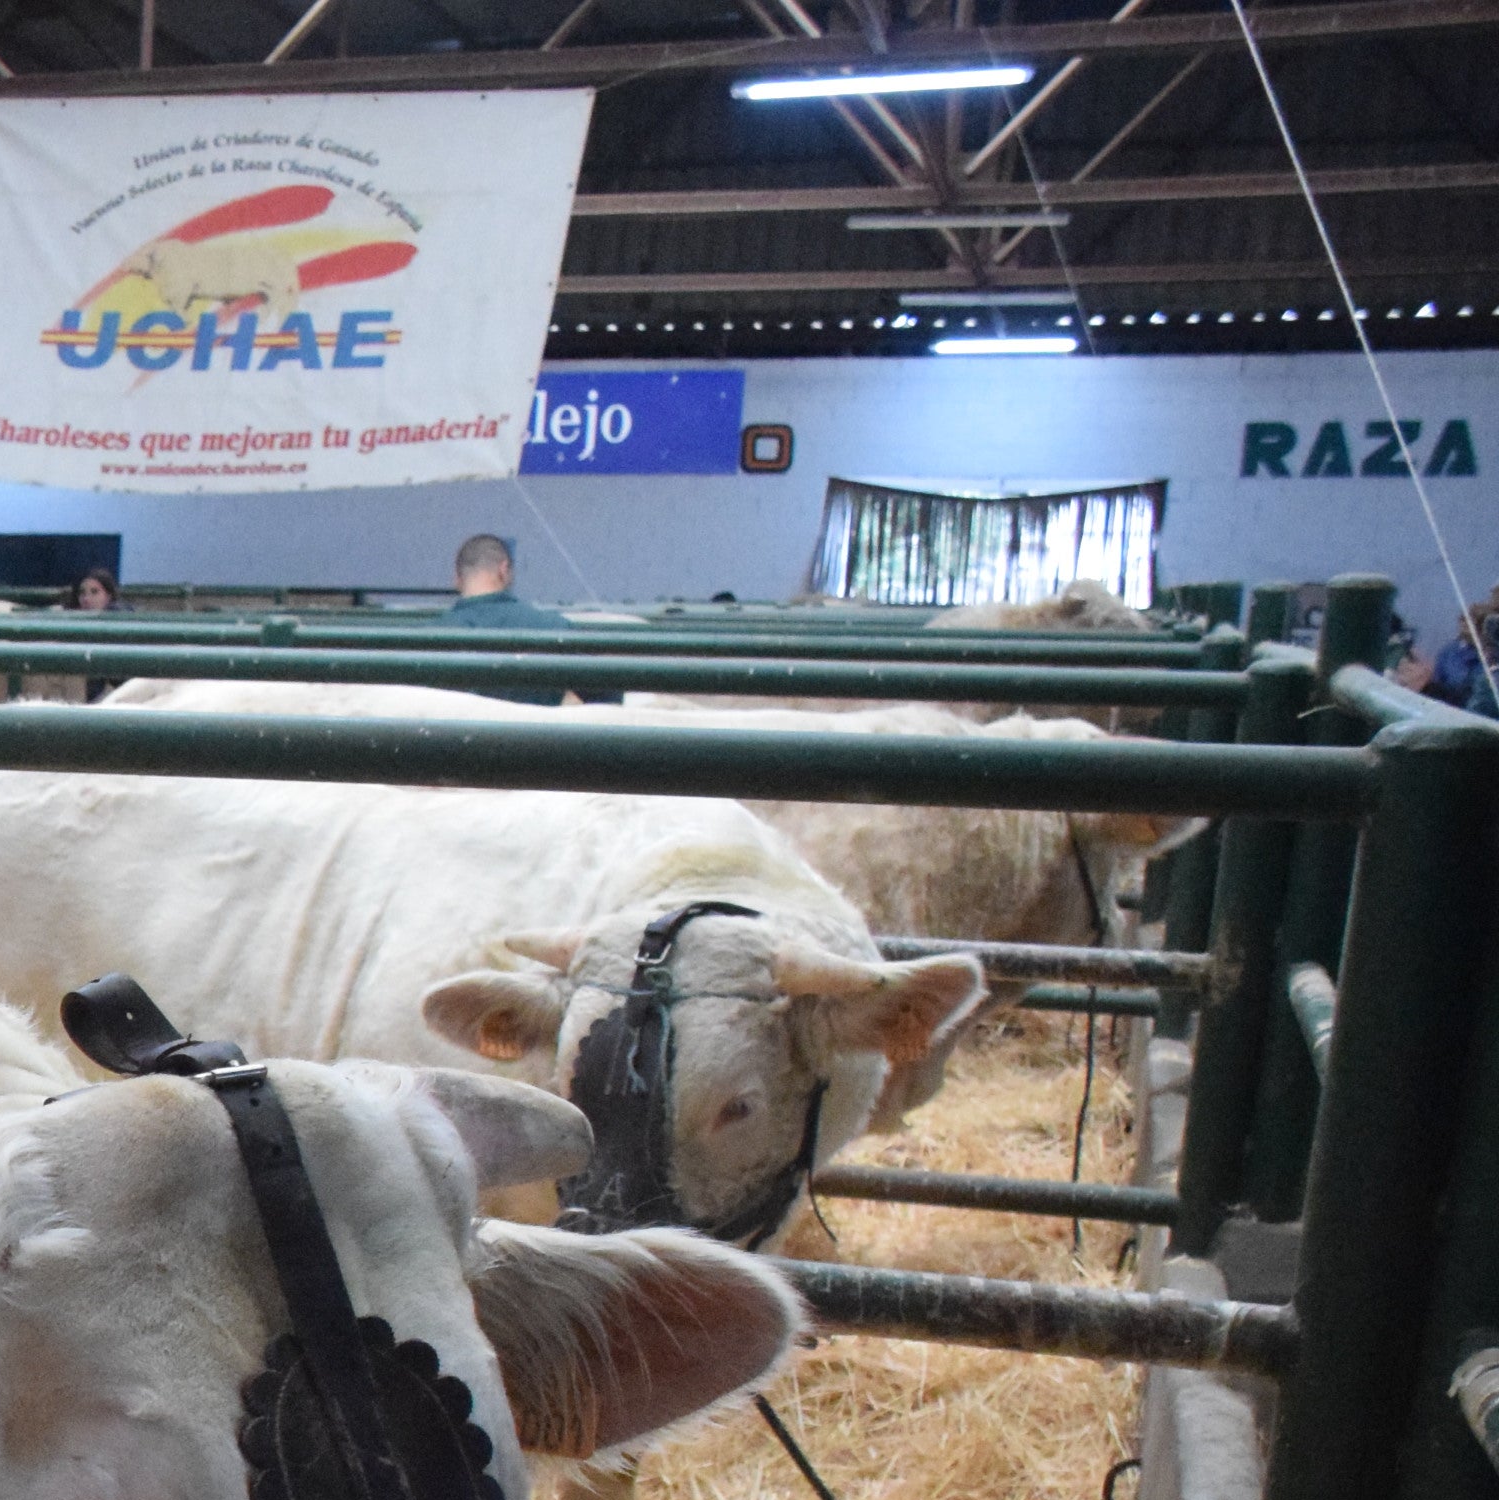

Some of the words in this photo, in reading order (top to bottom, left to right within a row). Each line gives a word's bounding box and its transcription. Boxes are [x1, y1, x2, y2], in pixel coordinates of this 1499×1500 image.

[190, 136, 207, 151] de
[295, 132, 313, 149] de
[188, 161, 205, 178] de
[211, 160, 226, 174] la
[232, 158, 272, 172] Raza
[356, 180, 374, 196] de
[55, 309, 395, 371] UCHAE
[140, 430, 191, 459] que
[200, 426, 312, 458] mejoran
[322, 423, 350, 448] tu
[1240, 419, 1477, 478] RAZA
